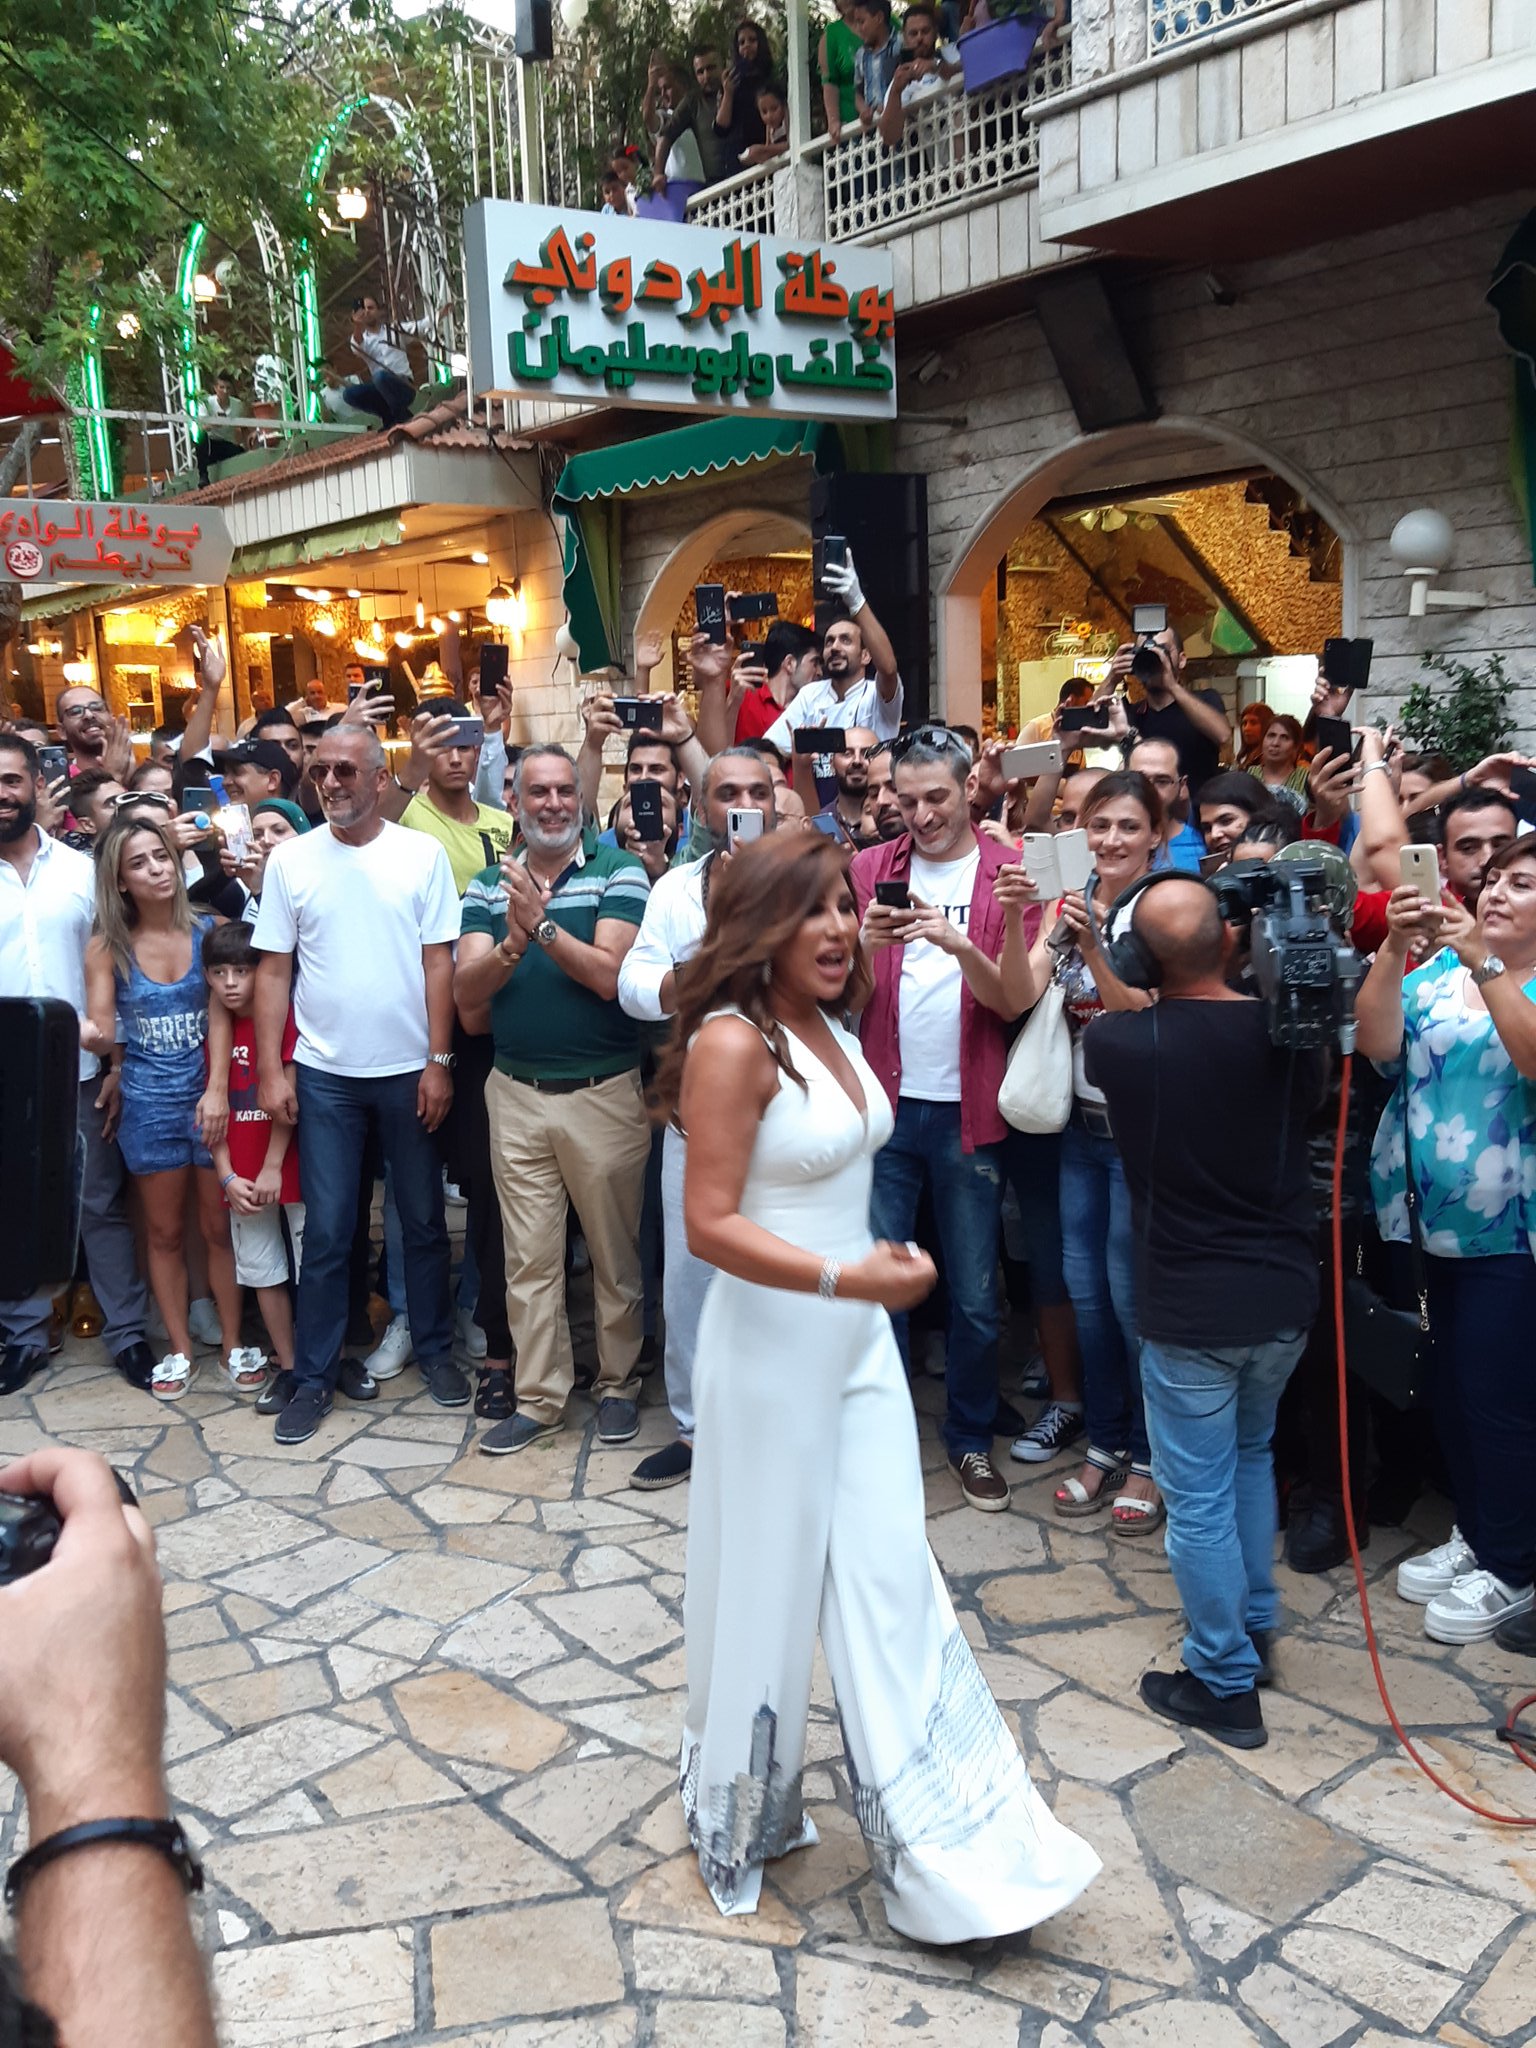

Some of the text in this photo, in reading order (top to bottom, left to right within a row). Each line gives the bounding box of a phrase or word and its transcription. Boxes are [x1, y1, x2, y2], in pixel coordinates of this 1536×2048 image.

[503, 225, 895, 339] بوظة البردوني
[776, 338, 894, 391] خلف
[103, 507, 201, 549] بوظة
[139, 1009, 208, 1054] PERFEC
